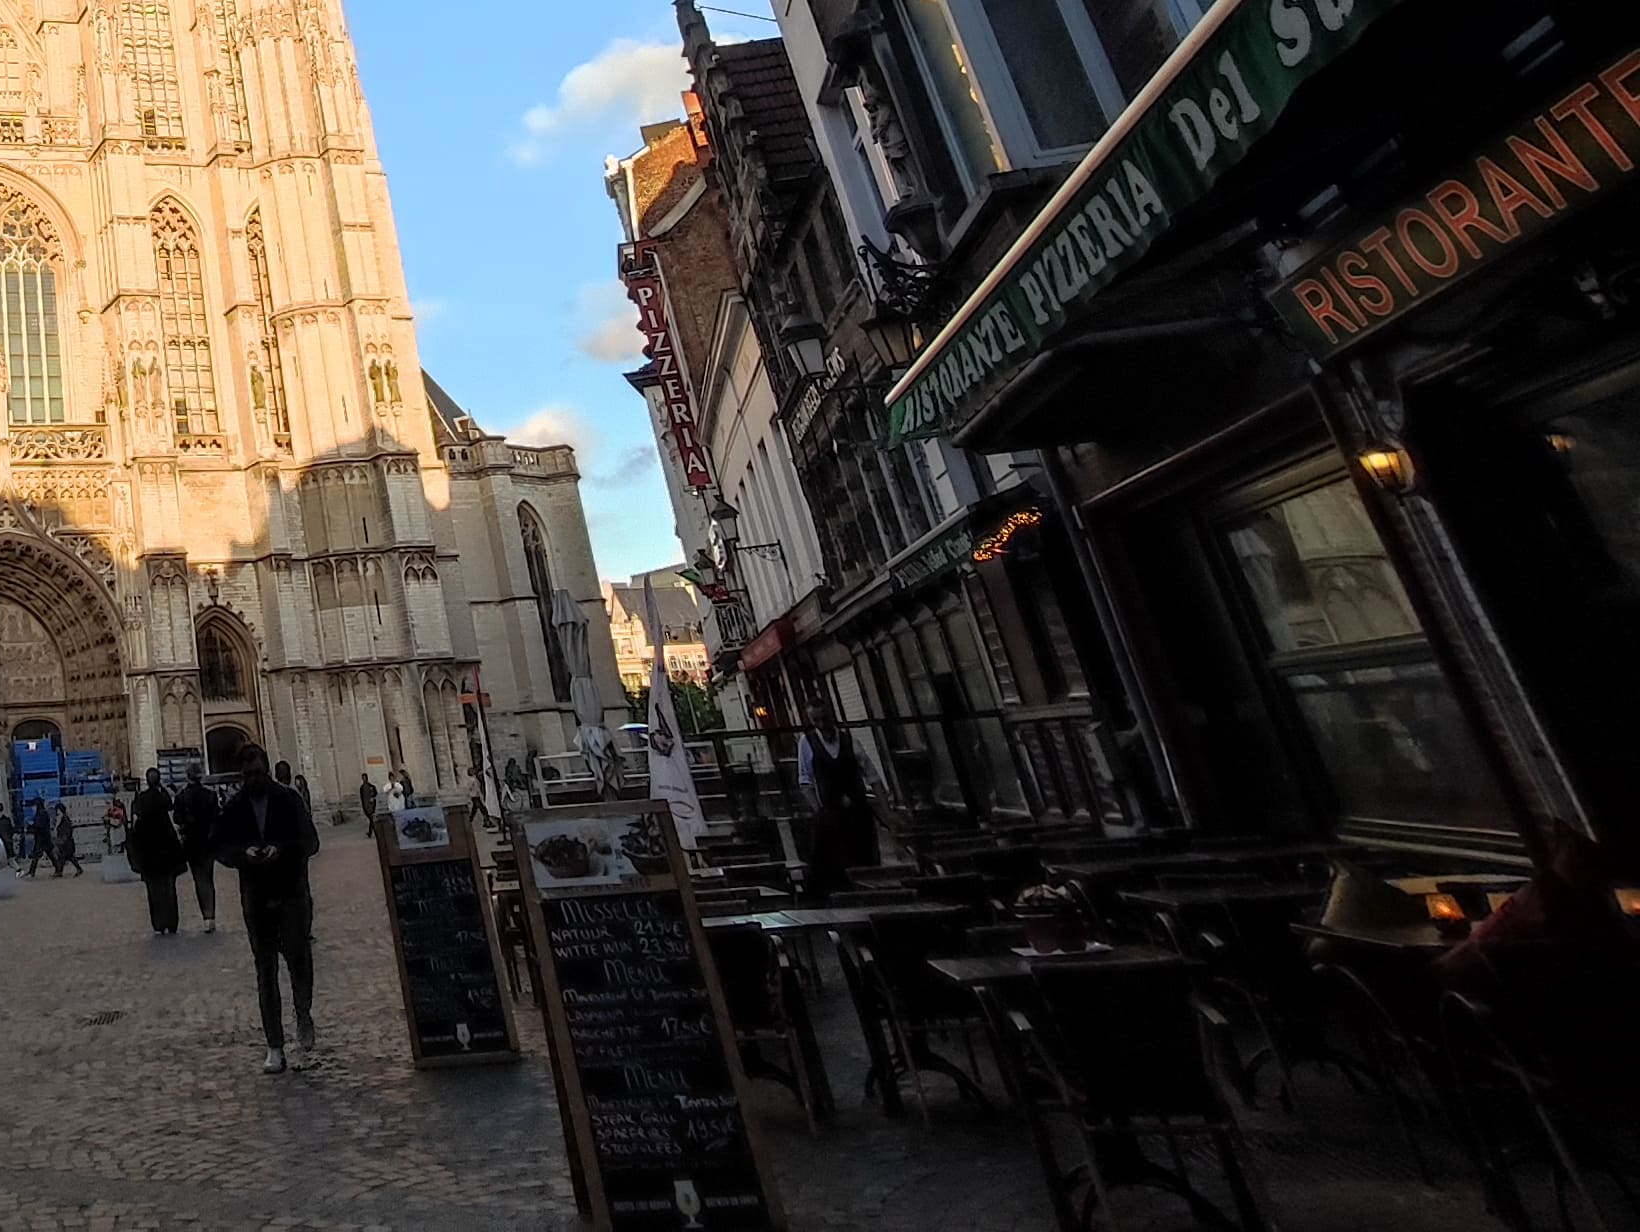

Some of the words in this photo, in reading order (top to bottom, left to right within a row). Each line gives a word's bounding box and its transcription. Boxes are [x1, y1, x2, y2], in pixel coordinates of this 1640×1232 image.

[636, 286, 707, 474] PIZZERIA
[900, 299, 1026, 435] RISTORANTE
[1018, 158, 1172, 327] PIZZERIA
[1168, 48, 1261, 172] Del
